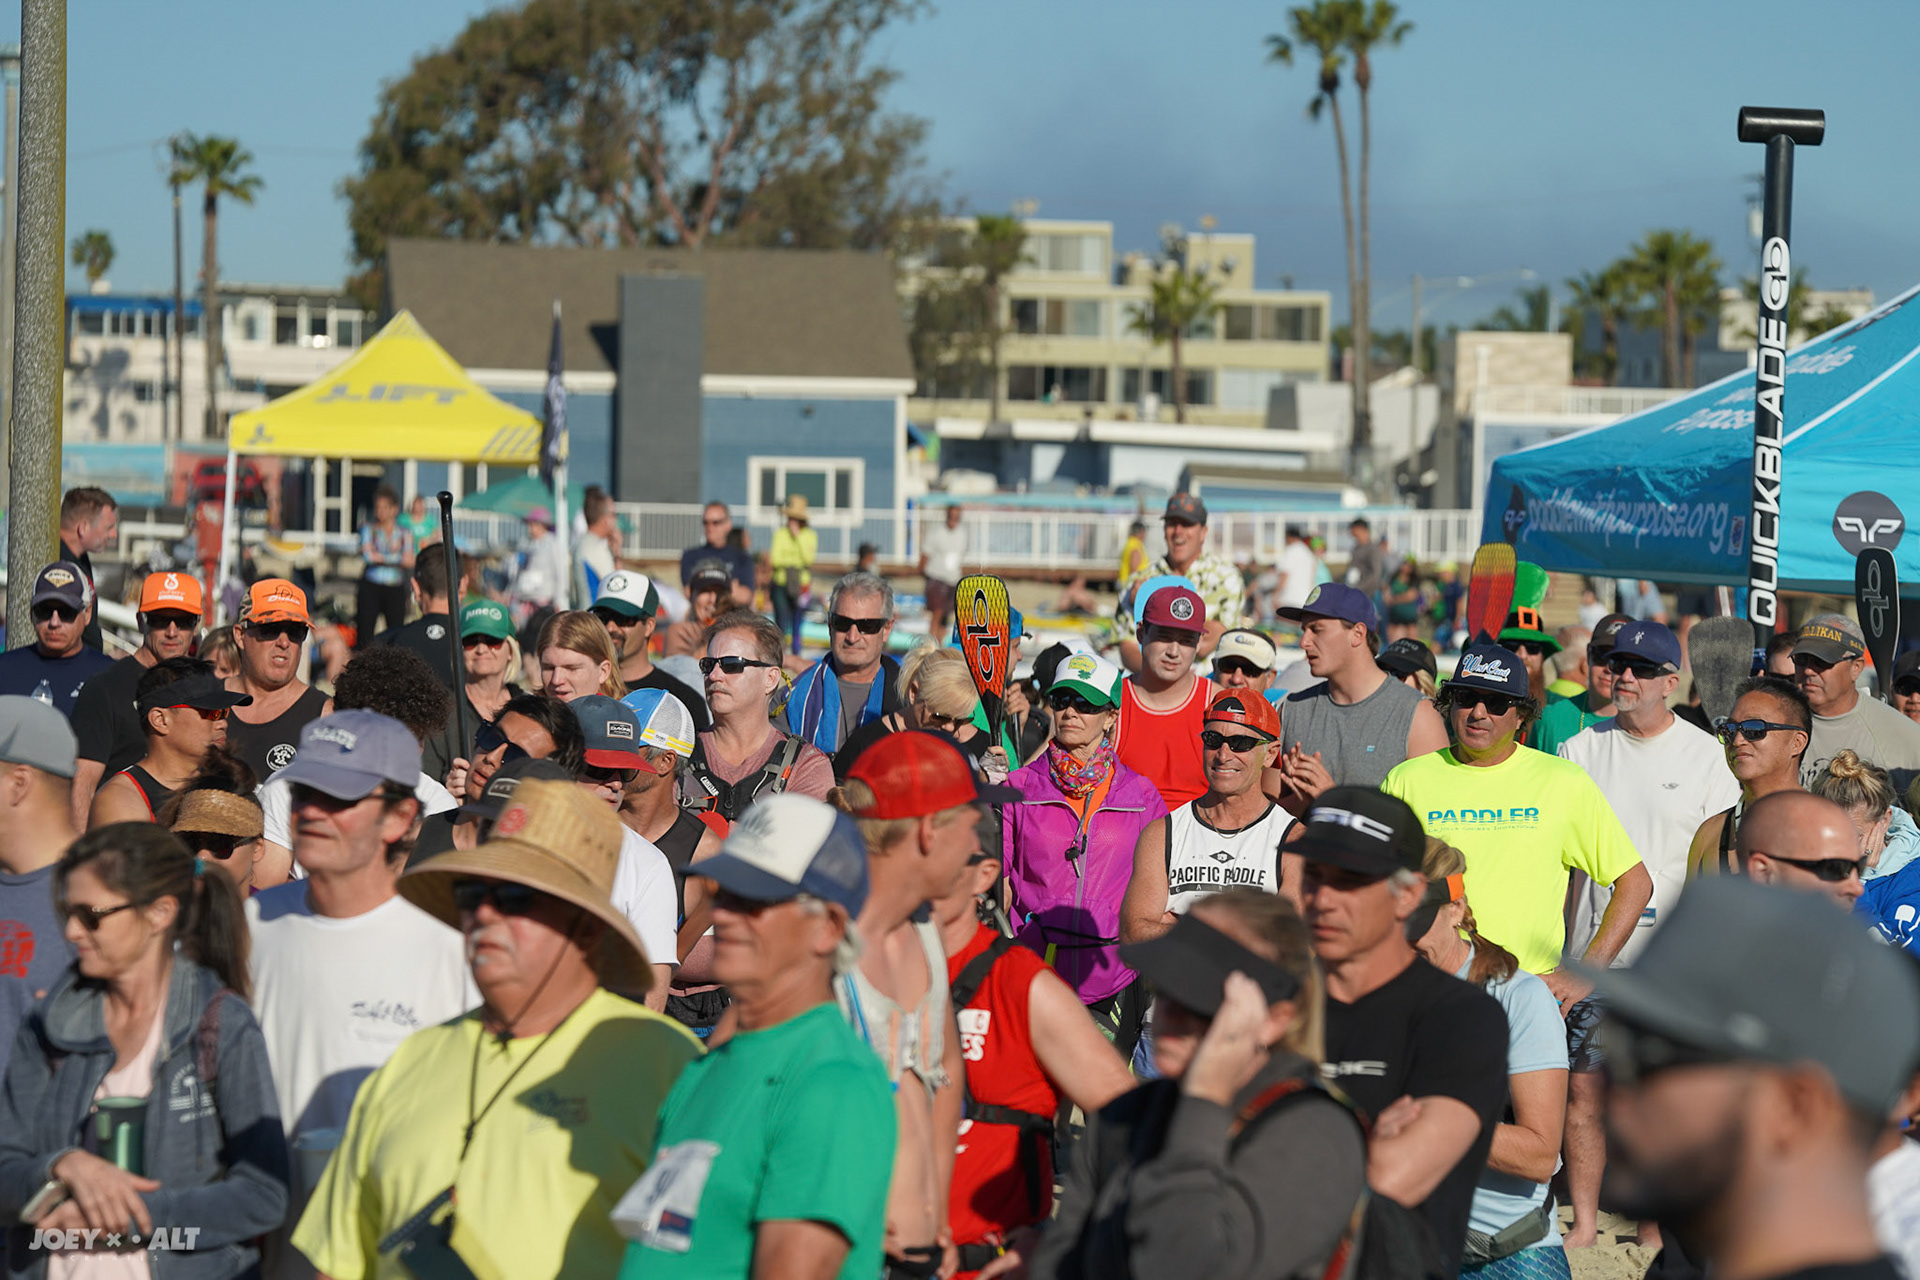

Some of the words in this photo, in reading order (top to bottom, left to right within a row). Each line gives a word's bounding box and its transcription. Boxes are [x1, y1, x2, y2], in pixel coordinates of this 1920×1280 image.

[314, 383, 468, 405] LIFT
[1750, 316, 1787, 627] QUICKBLADE
[1428, 807, 1539, 825] PADDLER
[1169, 866, 1220, 886] PACIFIC
